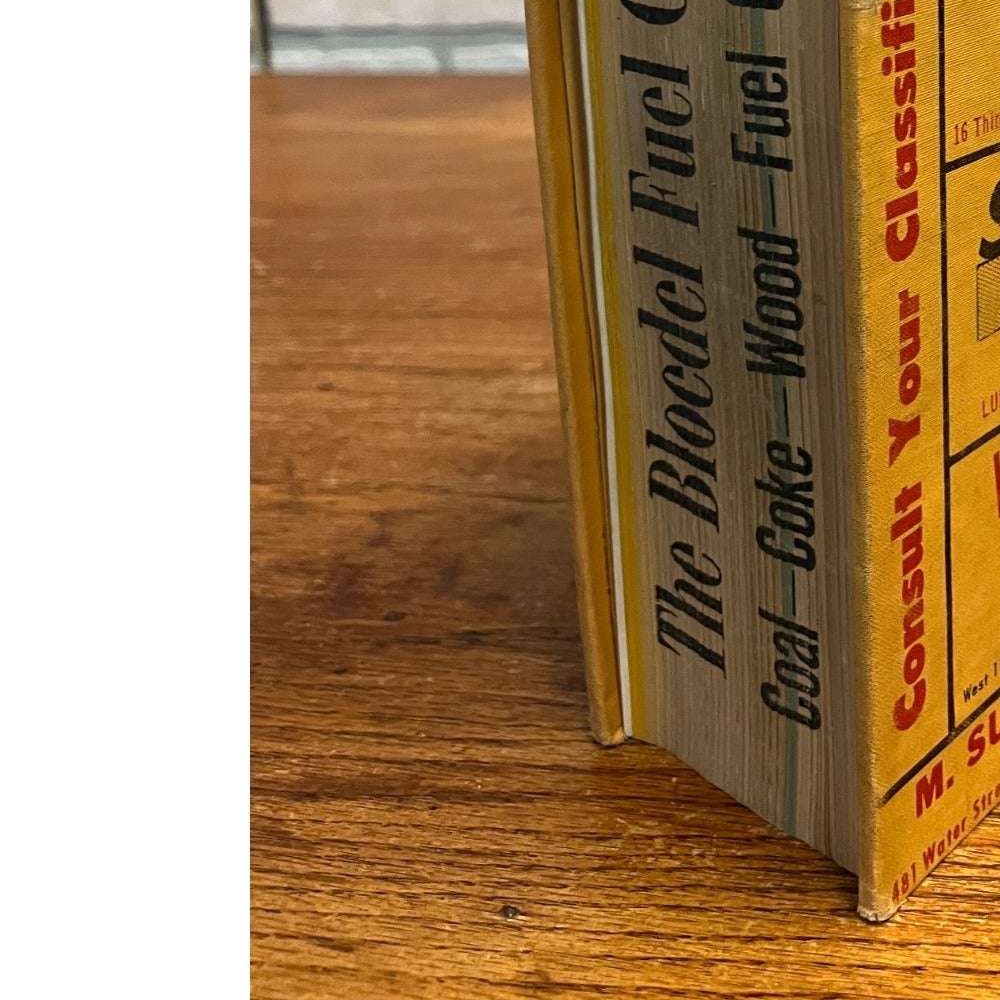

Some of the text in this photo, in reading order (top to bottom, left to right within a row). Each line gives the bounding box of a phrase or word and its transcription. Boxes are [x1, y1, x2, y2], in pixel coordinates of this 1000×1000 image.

[620, 54, 700, 231] Fuel
[724, 49, 794, 173] Fuel
[953, 122, 968, 145] 16
[737, 225, 807, 379] Wood
[888, 288, 922, 467] Your
[754, 440, 817, 573] Coke
[655, 539, 727, 679] The
[758, 606, 822, 731] Coal
[891, 480, 926, 731] Consult
[963, 675, 989, 703] West
[915, 761, 954, 818] M.
[892, 862, 917, 903] 481
[923, 816, 967, 871] Water
